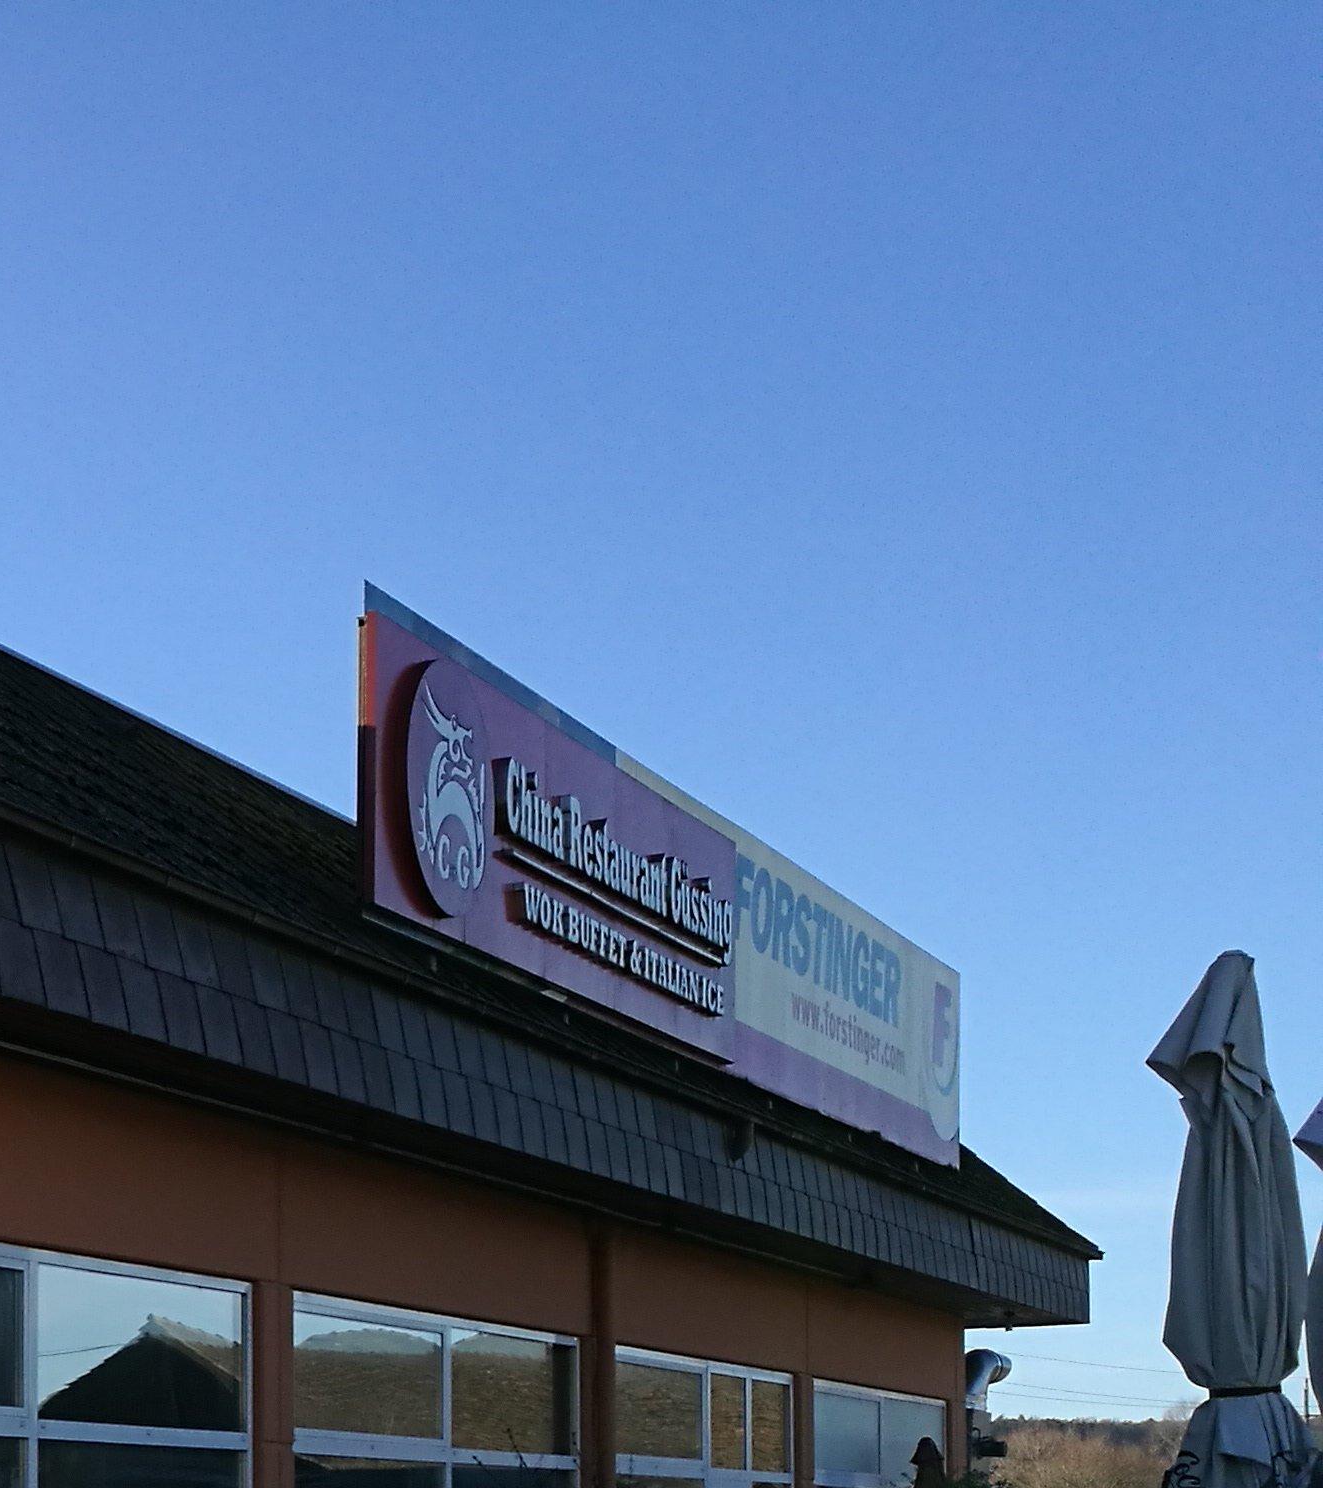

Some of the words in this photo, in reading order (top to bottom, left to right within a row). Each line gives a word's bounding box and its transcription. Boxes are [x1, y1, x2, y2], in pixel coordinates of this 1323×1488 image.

[506, 756, 564, 860] China
[569, 795, 669, 918] Restaurant
[524, 883, 564, 938] WOK
[568, 906, 627, 969] BUFFET
[630, 940, 642, 976] &
[644, 947, 699, 1004] ITALIAN
[702, 977, 725, 1014] ICE
[735, 853, 902, 1029] FORSTINGER
[790, 992, 906, 1076] www.forstinger.com
[931, 981, 954, 1068] F
